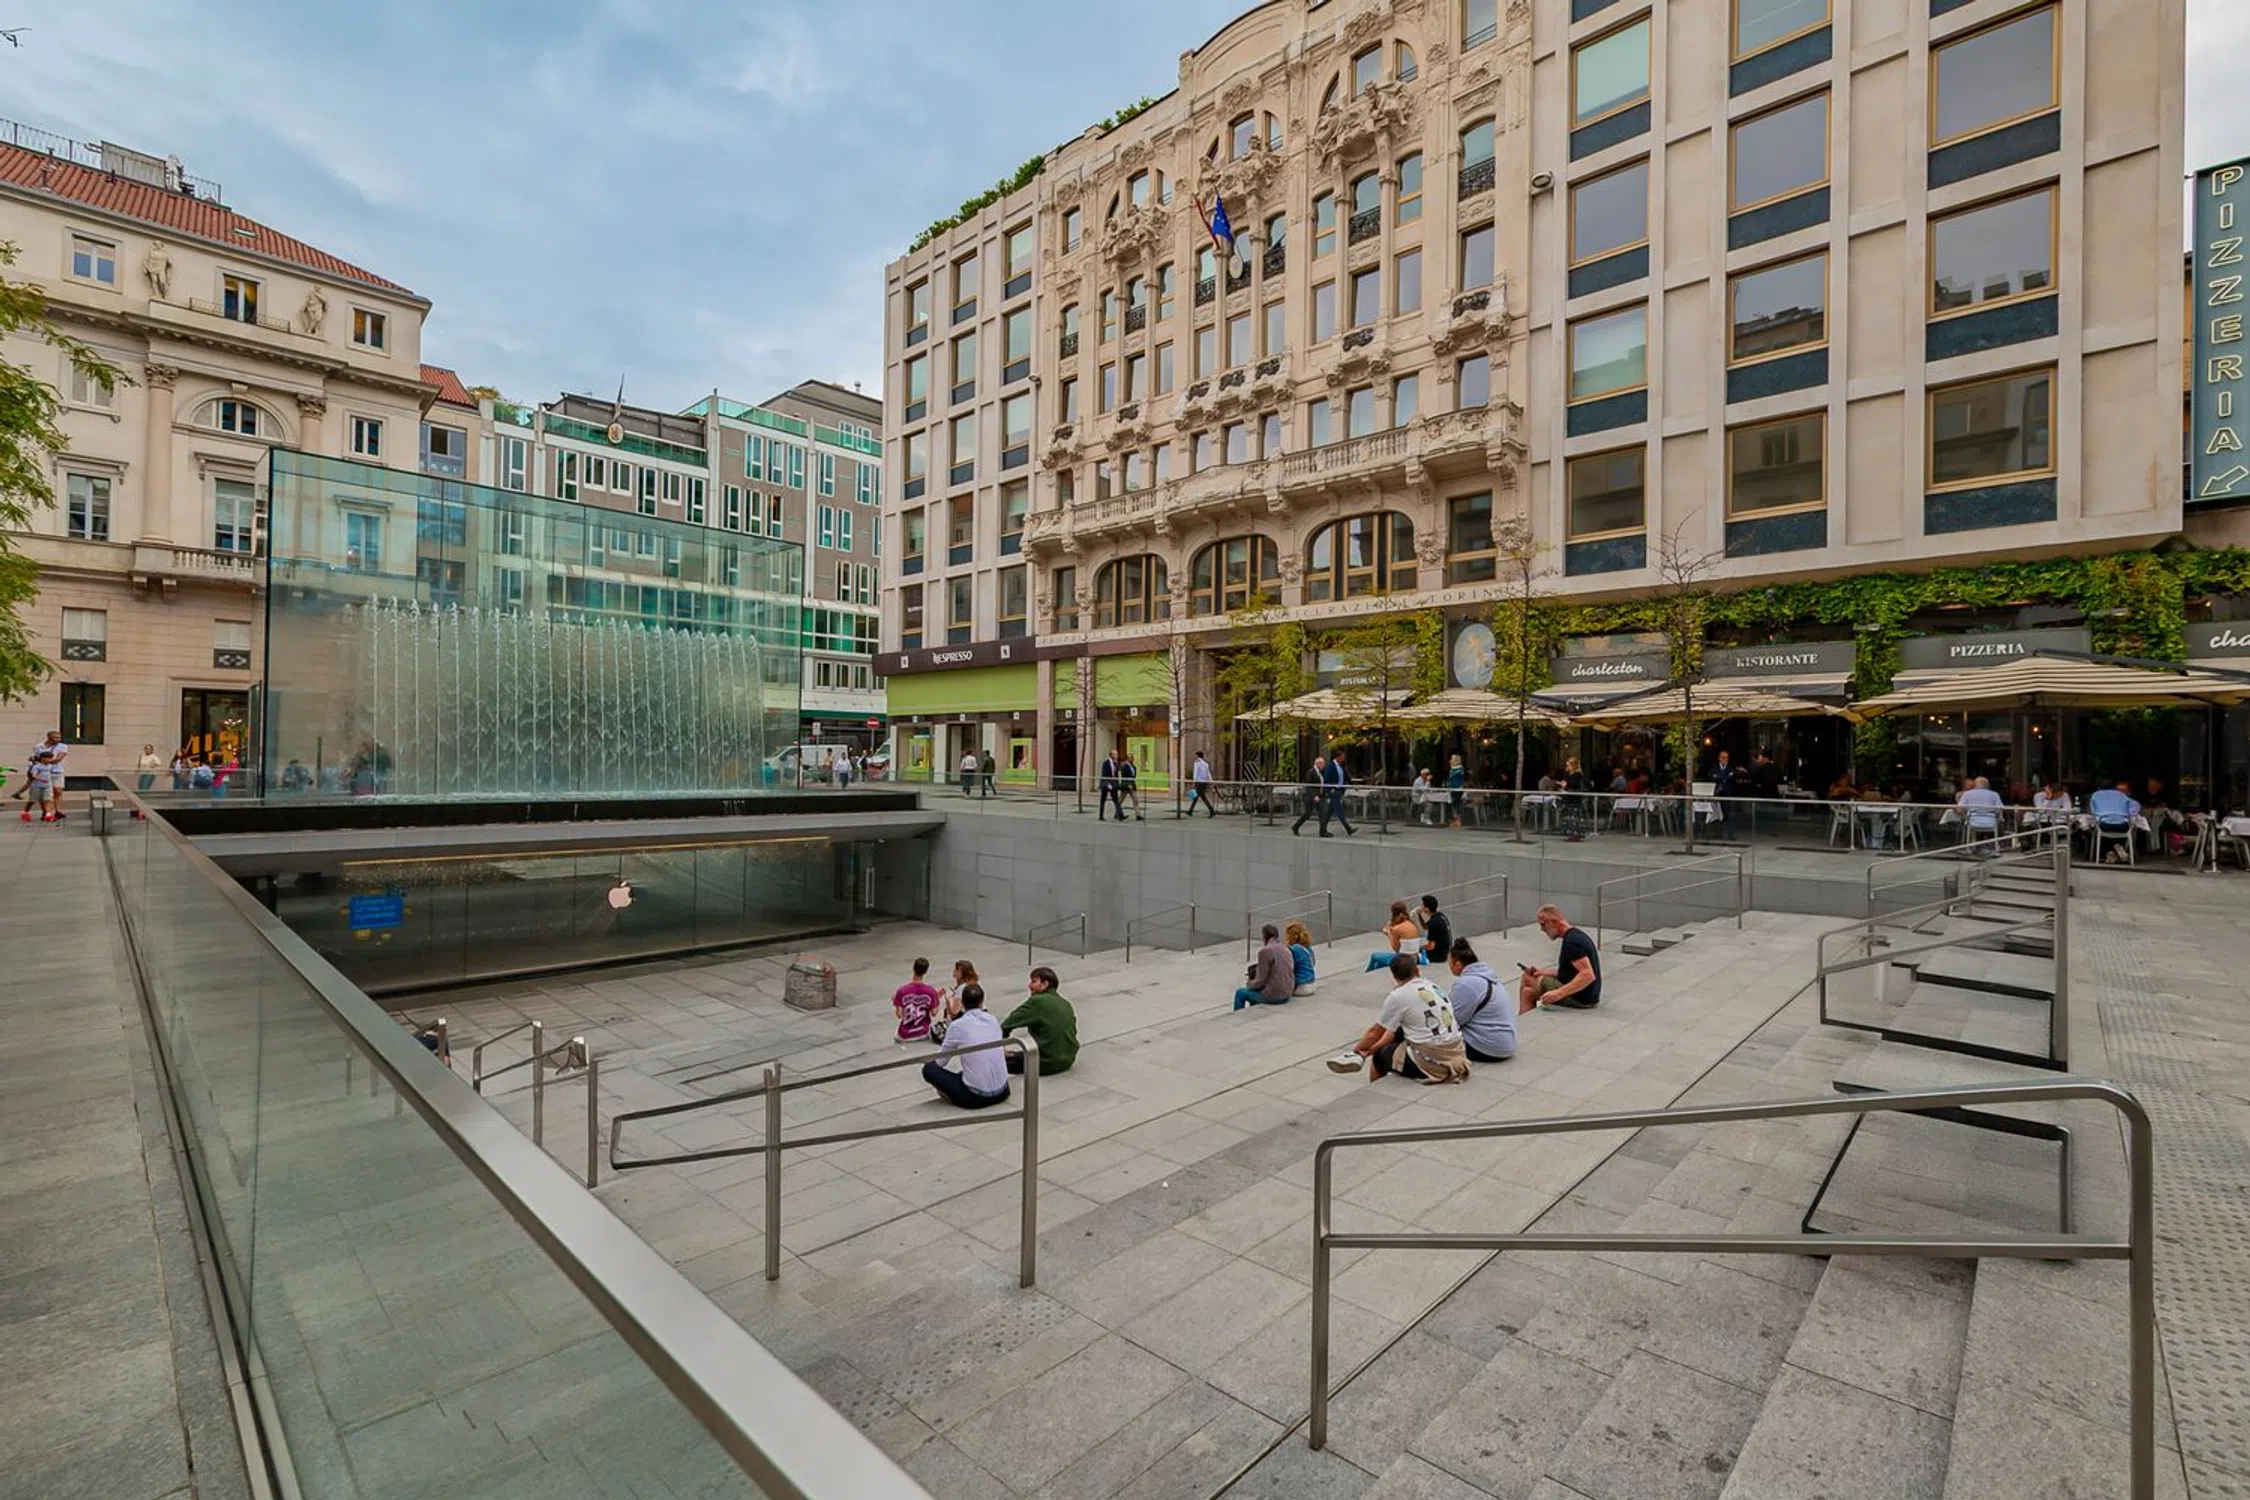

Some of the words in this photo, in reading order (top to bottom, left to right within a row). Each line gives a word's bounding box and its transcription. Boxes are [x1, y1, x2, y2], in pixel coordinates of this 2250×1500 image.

[2205, 165, 2244, 454] PIZZERIA
[1950, 643, 2024, 657] PIZZERIA
[1736, 653, 1818, 667] RISTORANTE
[1571, 661, 1643, 677] charleston
